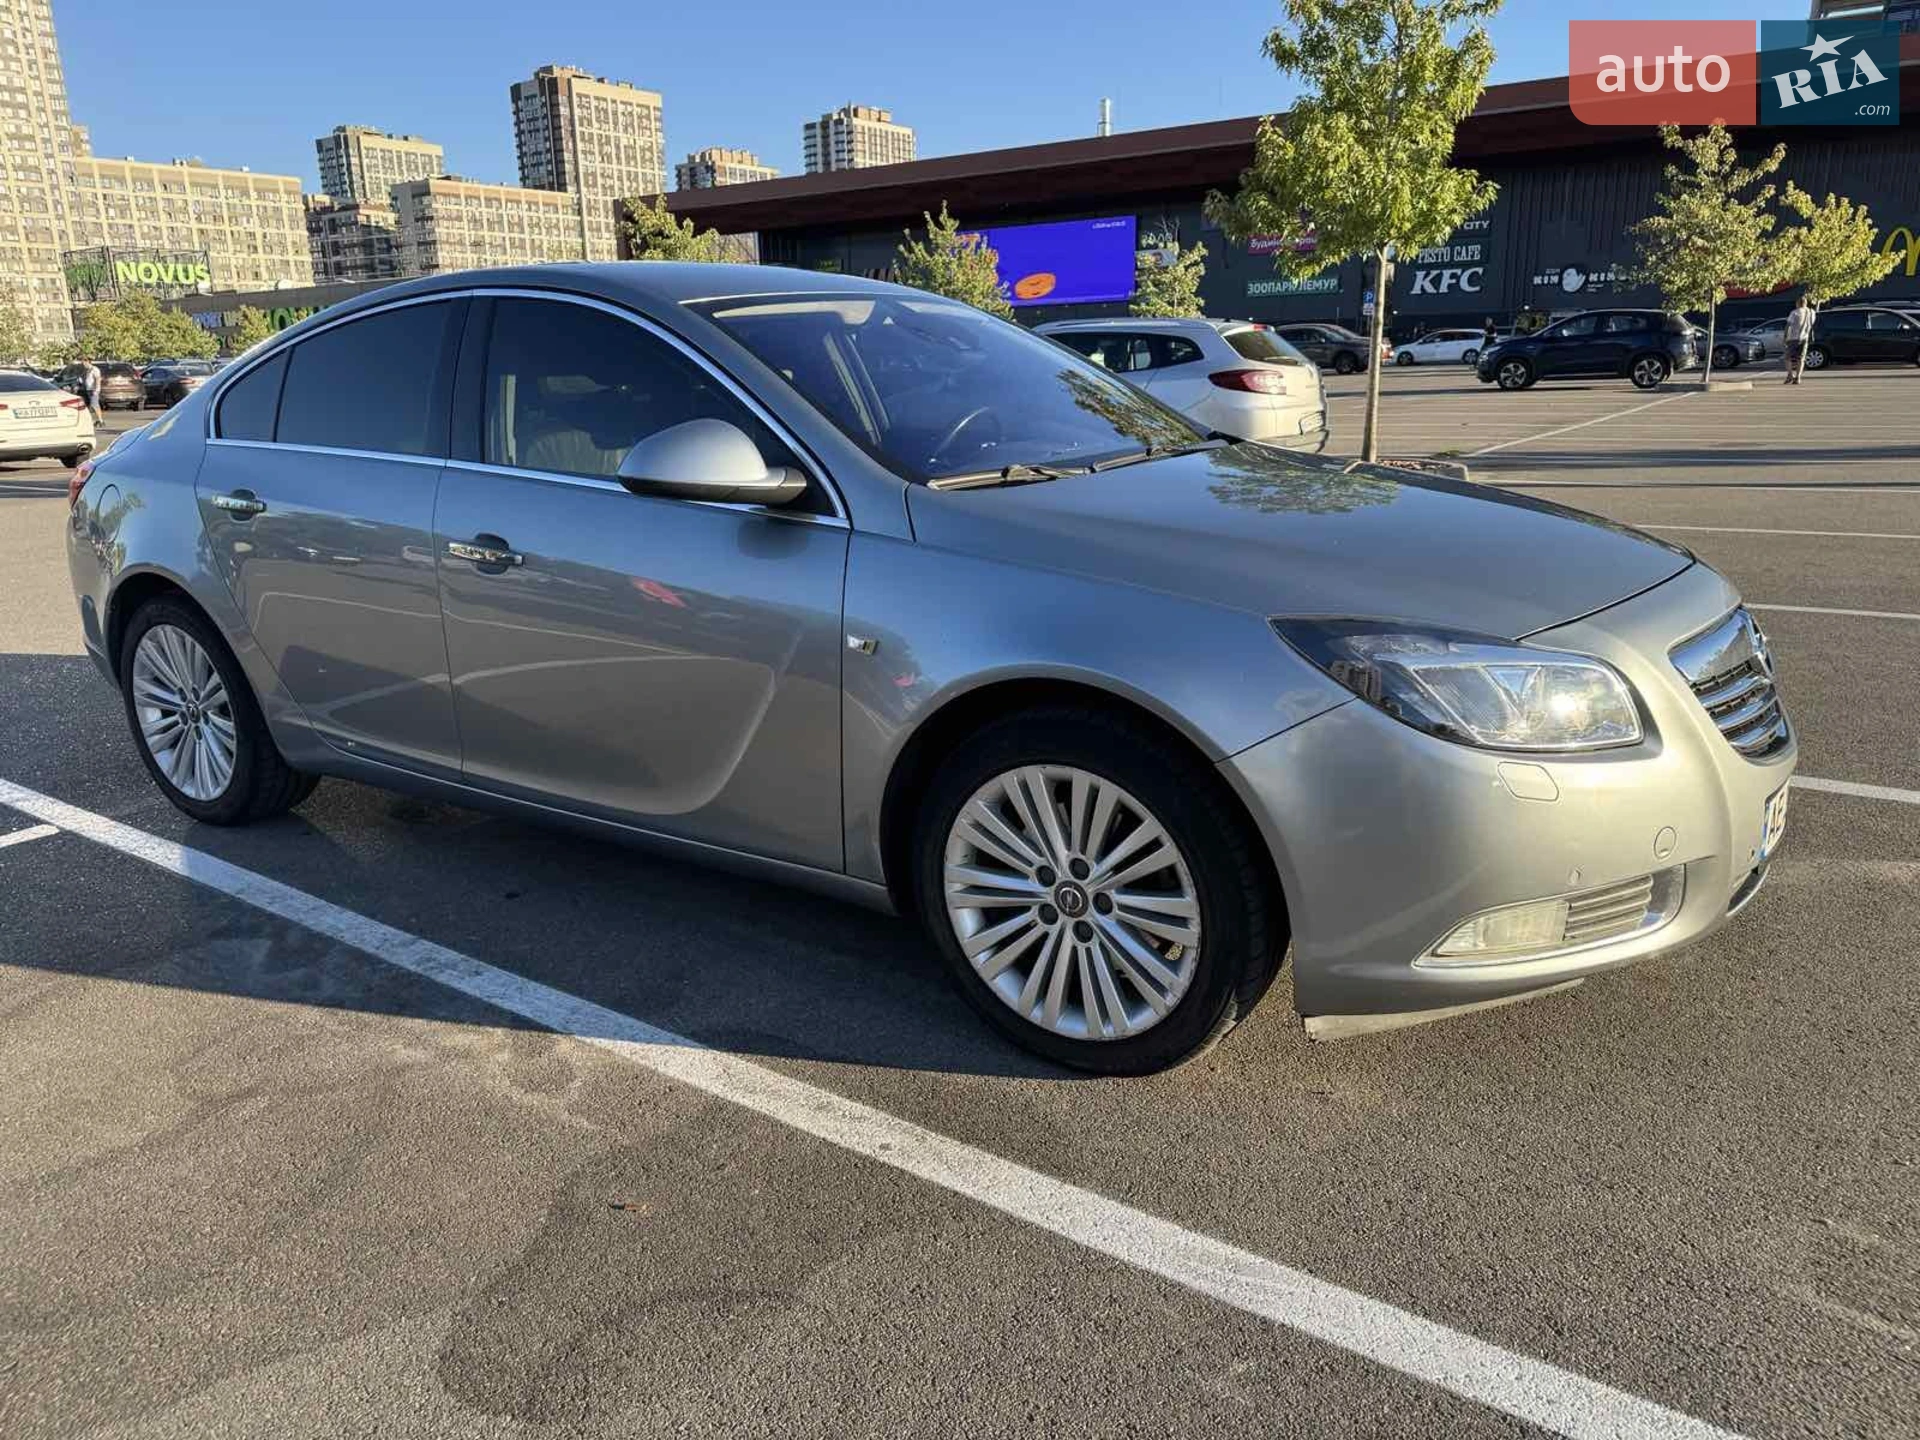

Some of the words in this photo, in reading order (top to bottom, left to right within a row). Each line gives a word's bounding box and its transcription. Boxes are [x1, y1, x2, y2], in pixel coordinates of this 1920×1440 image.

[1418, 246, 1450, 263] PESTO
[1454, 245, 1481, 261] CAFE
[115, 259, 210, 285] NOVUS
[1410, 267, 1484, 294] KFC
